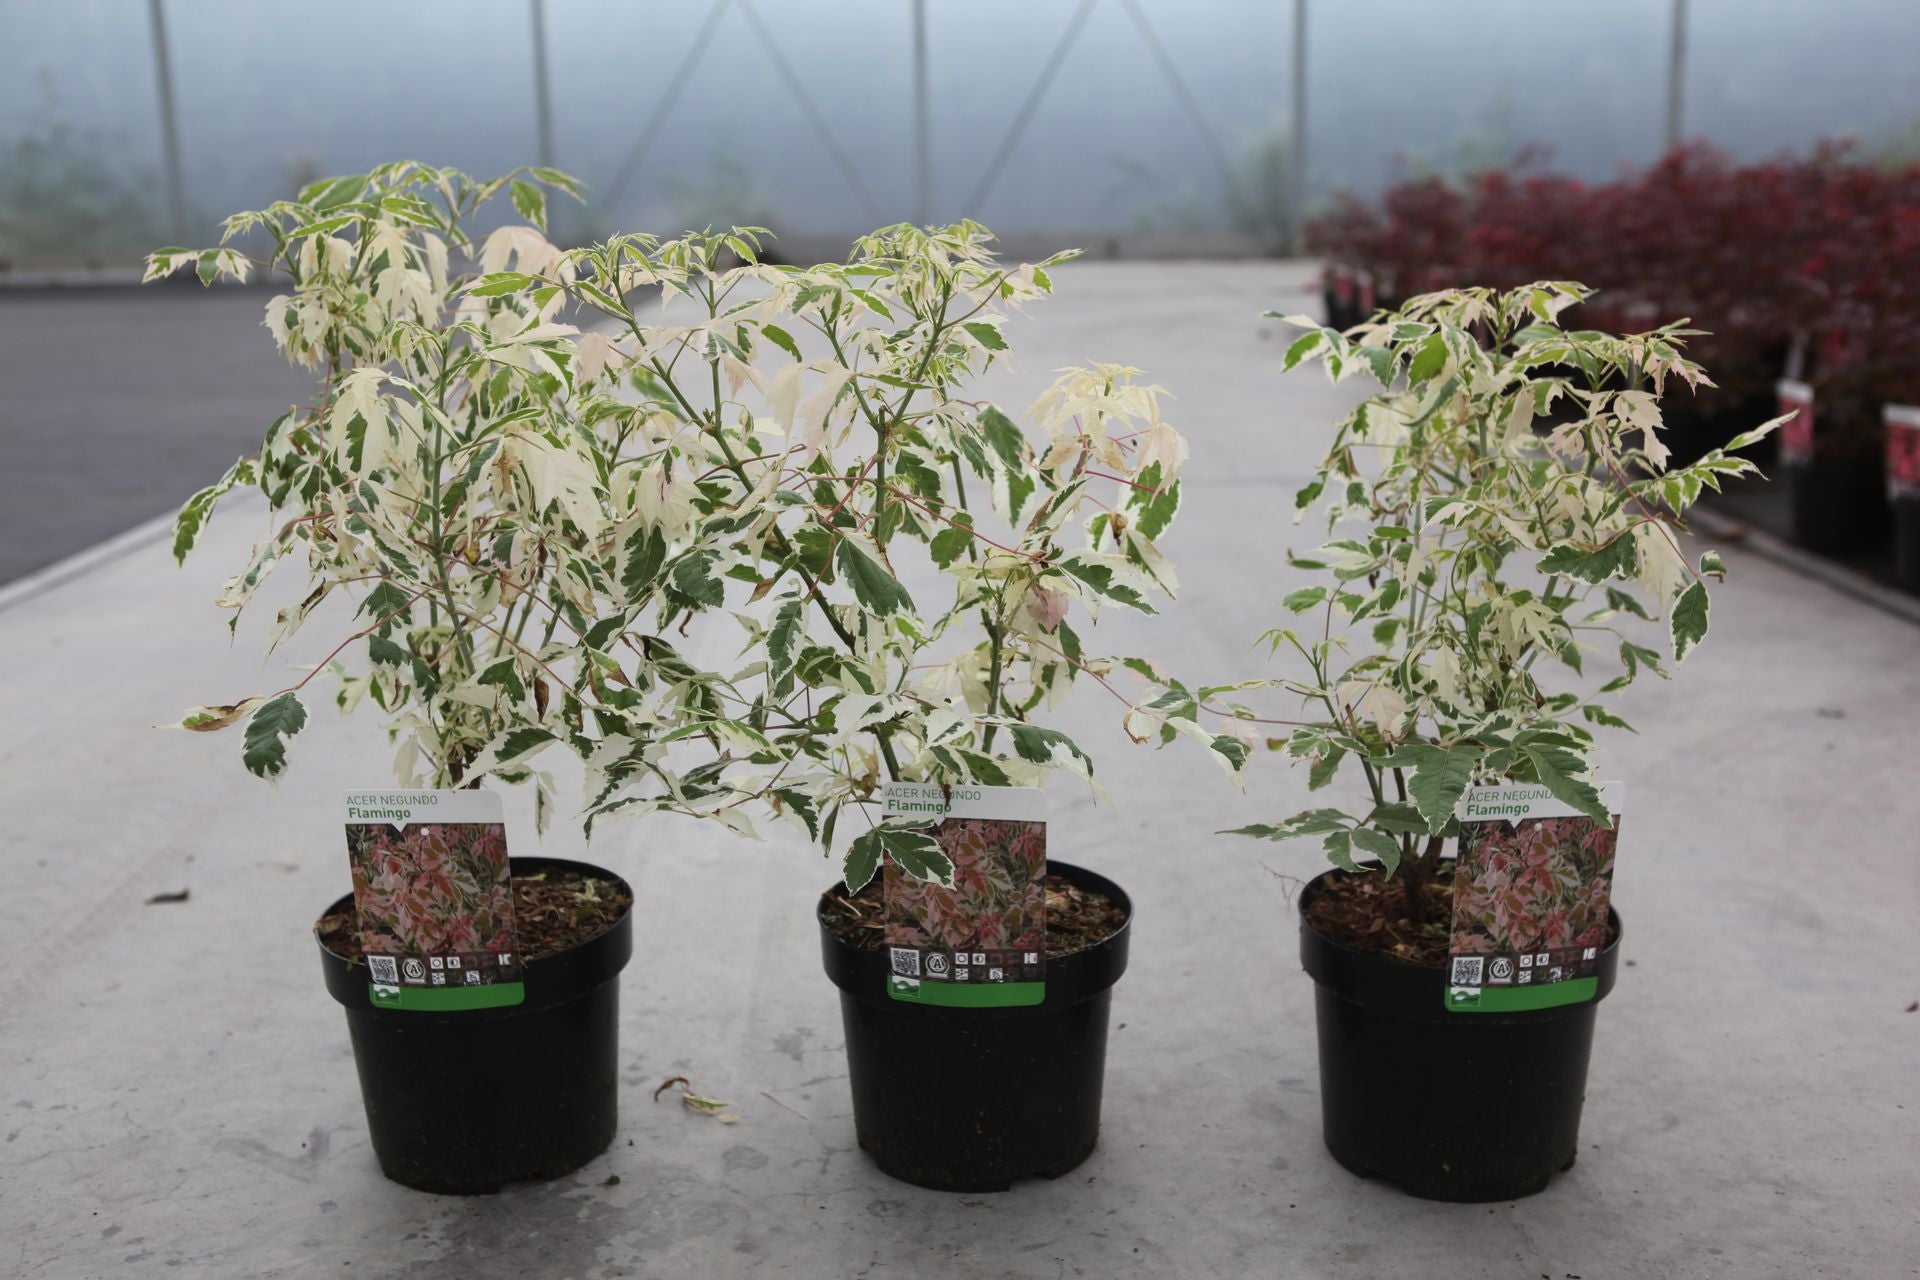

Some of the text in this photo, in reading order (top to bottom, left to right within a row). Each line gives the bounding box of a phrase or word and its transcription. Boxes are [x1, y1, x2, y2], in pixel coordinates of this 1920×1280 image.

[887, 787, 919, 798] ACER
[1468, 789, 1553, 802] ACER NEGUND
[346, 794, 438, 806] ACER NEGUNDO
[888, 799, 952, 815] Flamingo
[1466, 803, 1530, 816] Flamingo
[348, 807, 411, 821] Flamingo
